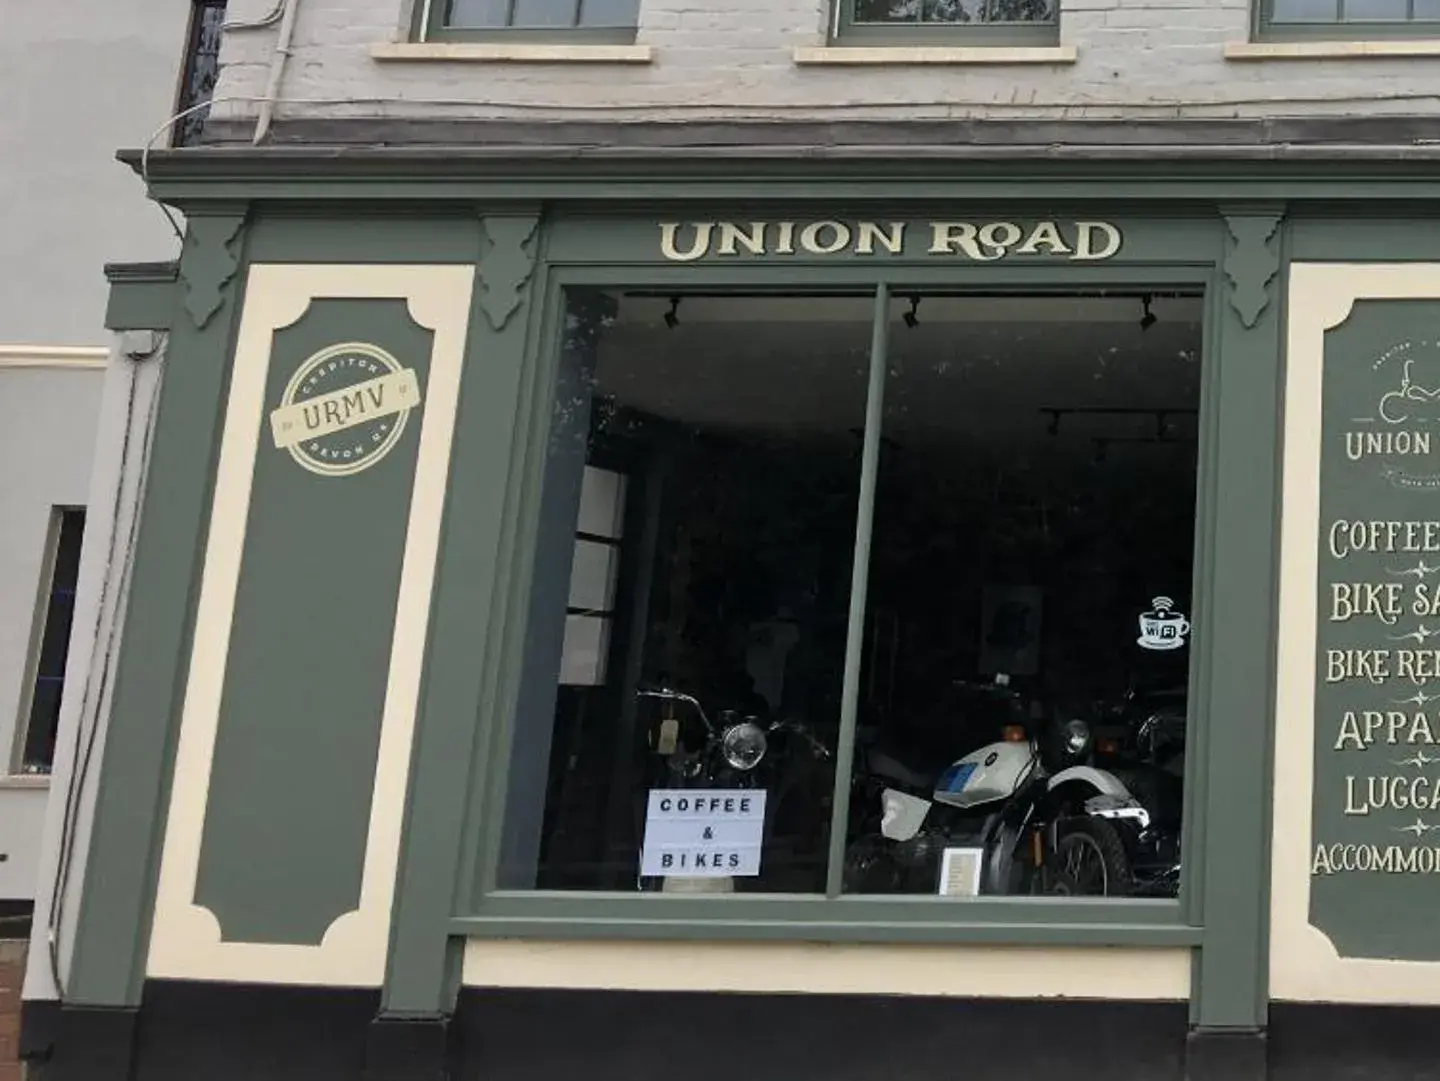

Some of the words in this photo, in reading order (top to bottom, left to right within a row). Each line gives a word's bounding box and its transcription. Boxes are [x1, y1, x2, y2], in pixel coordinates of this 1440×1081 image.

[658, 221, 906, 261] UNION
[929, 221, 1123, 261] ROAD
[303, 383, 385, 430] URMV
[1346, 432, 1430, 460] UNION
[1330, 583, 1404, 625] BIKE
[1325, 650, 1390, 684] BIKE
[659, 797, 752, 813] COFFEE
[702, 826, 713, 840] &
[661, 853, 740, 868] BIKES
